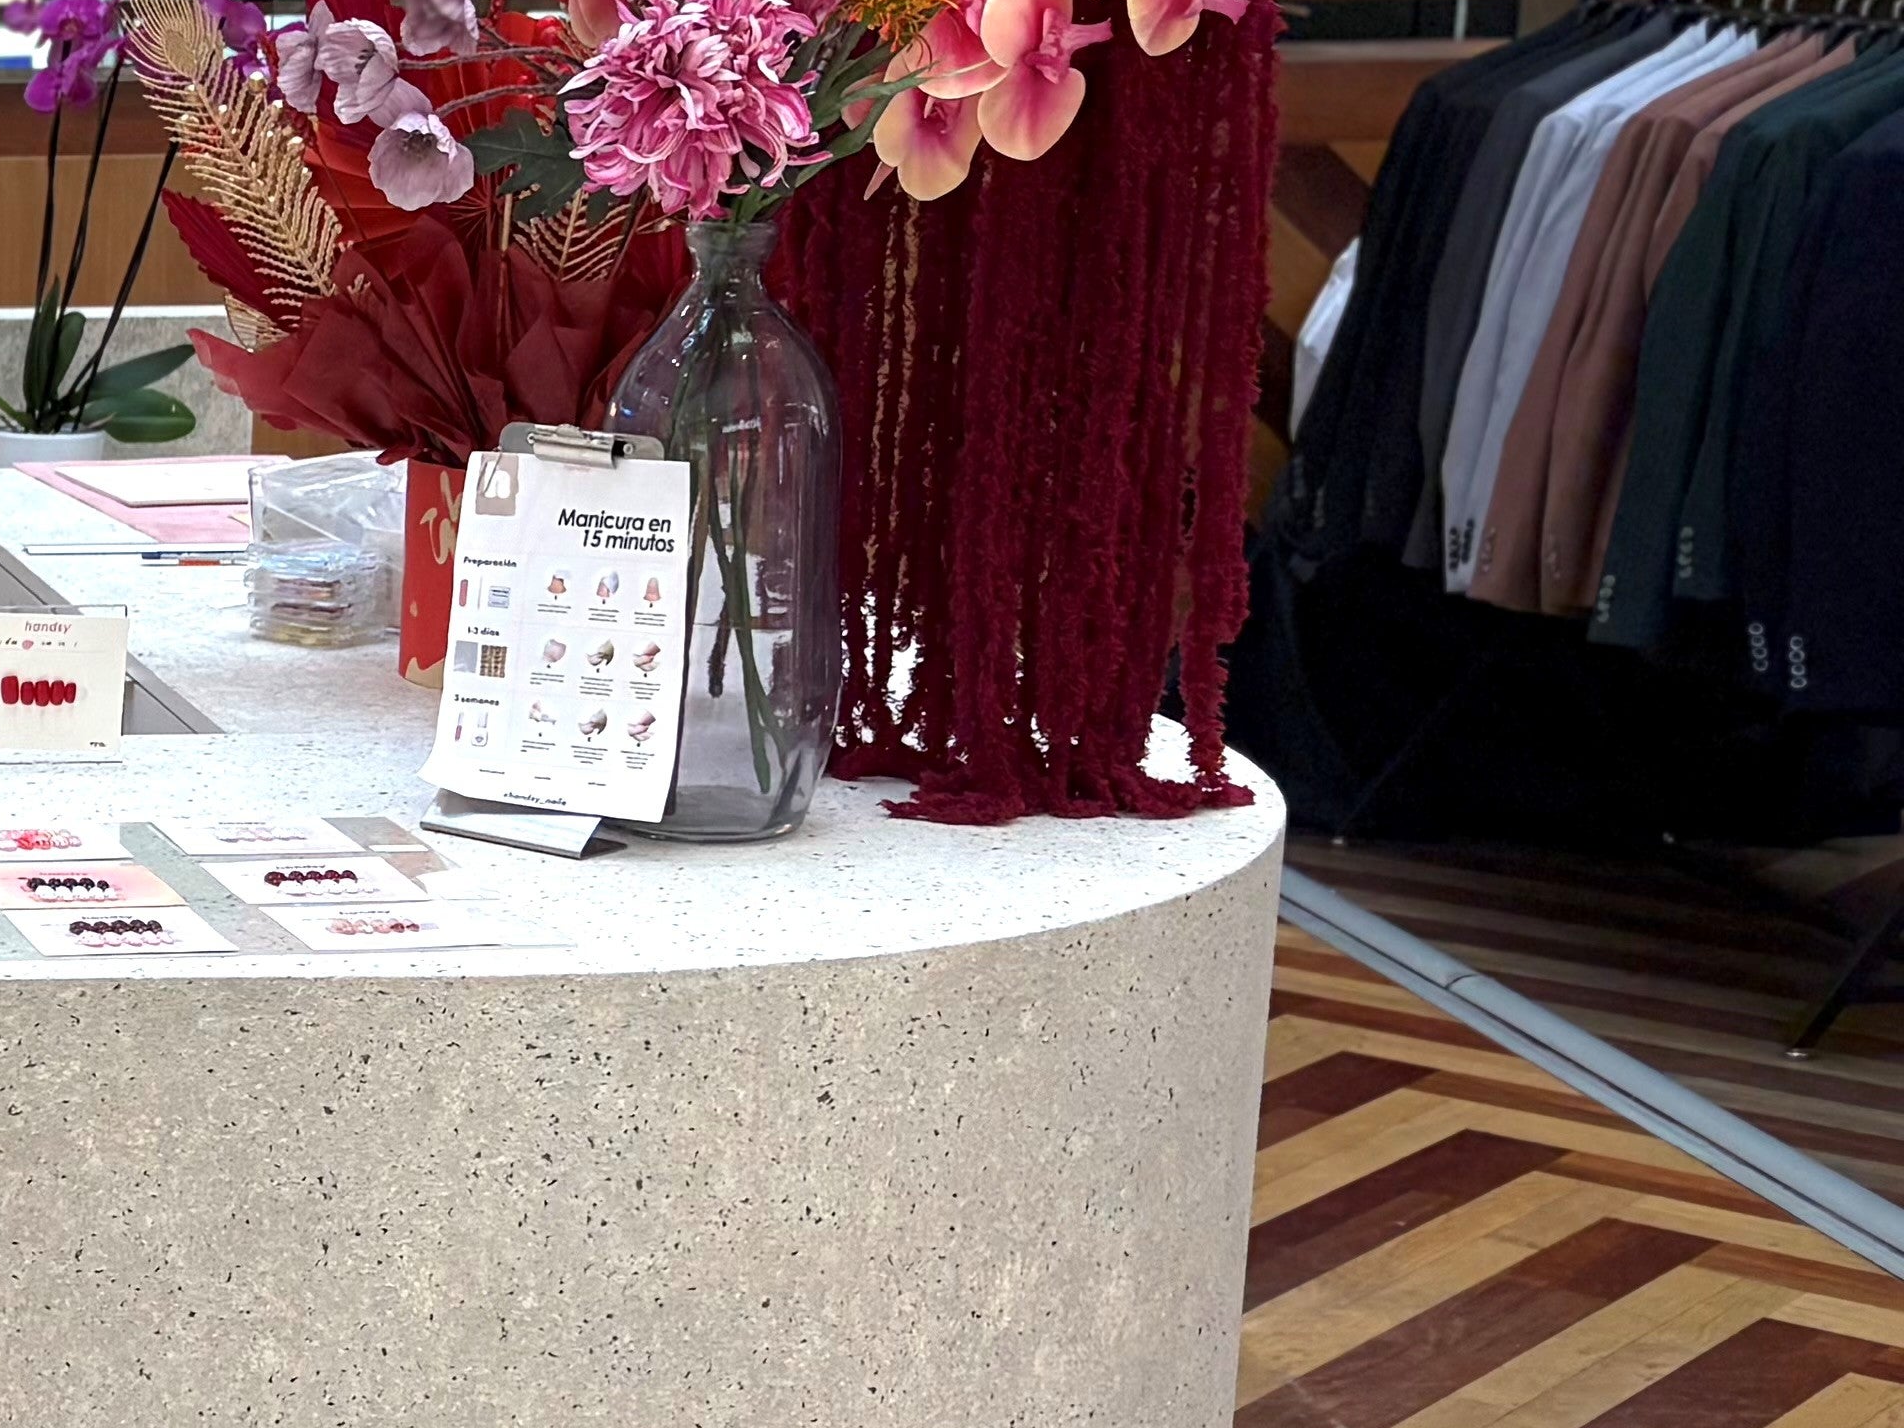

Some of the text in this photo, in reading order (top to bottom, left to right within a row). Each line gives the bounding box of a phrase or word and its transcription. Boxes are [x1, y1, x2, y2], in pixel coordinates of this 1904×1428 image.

[558, 508, 672, 534] Manicura en
[582, 529, 675, 553] 15 minutos
[24, 620, 73, 634] handsy
